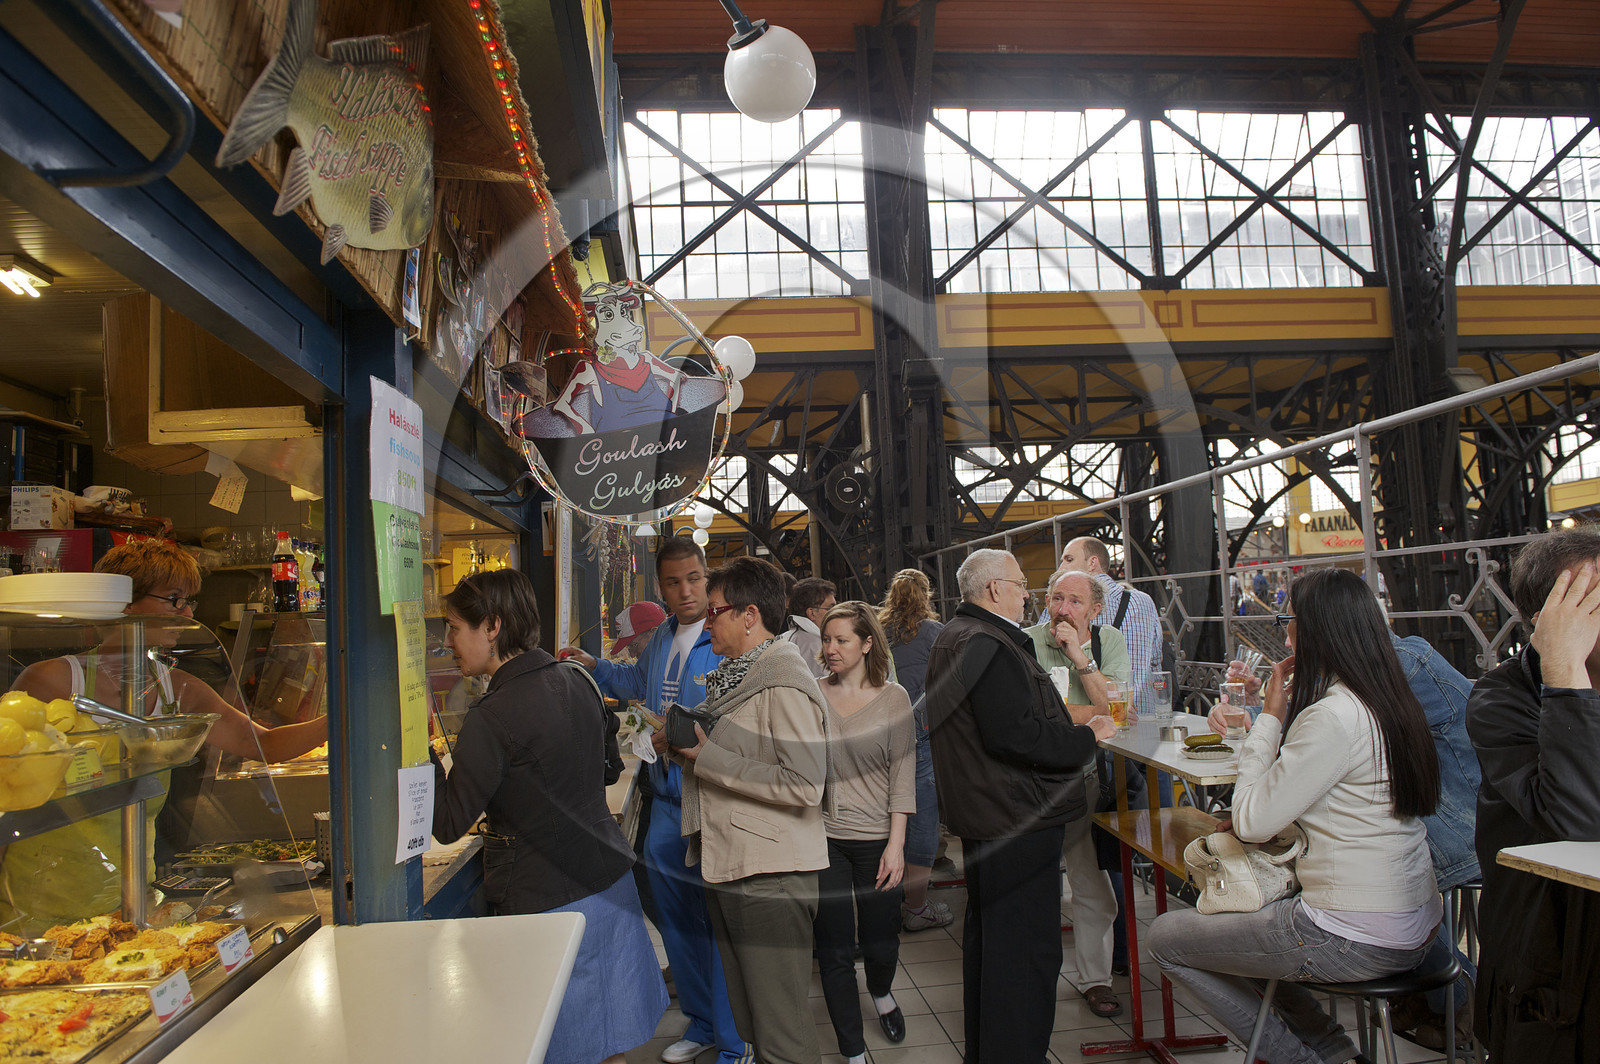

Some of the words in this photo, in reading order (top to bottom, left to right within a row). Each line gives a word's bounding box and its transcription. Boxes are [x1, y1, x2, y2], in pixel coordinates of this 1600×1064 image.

[308, 124, 367, 181] Fisch
[359, 139, 408, 198] suppe
[388, 407, 421, 440] Halászlé
[388, 436, 421, 469] fishsoup
[574, 427, 688, 476] Goulash
[397, 469, 417, 492] 850ft
[589, 470, 688, 510] Gulyás
